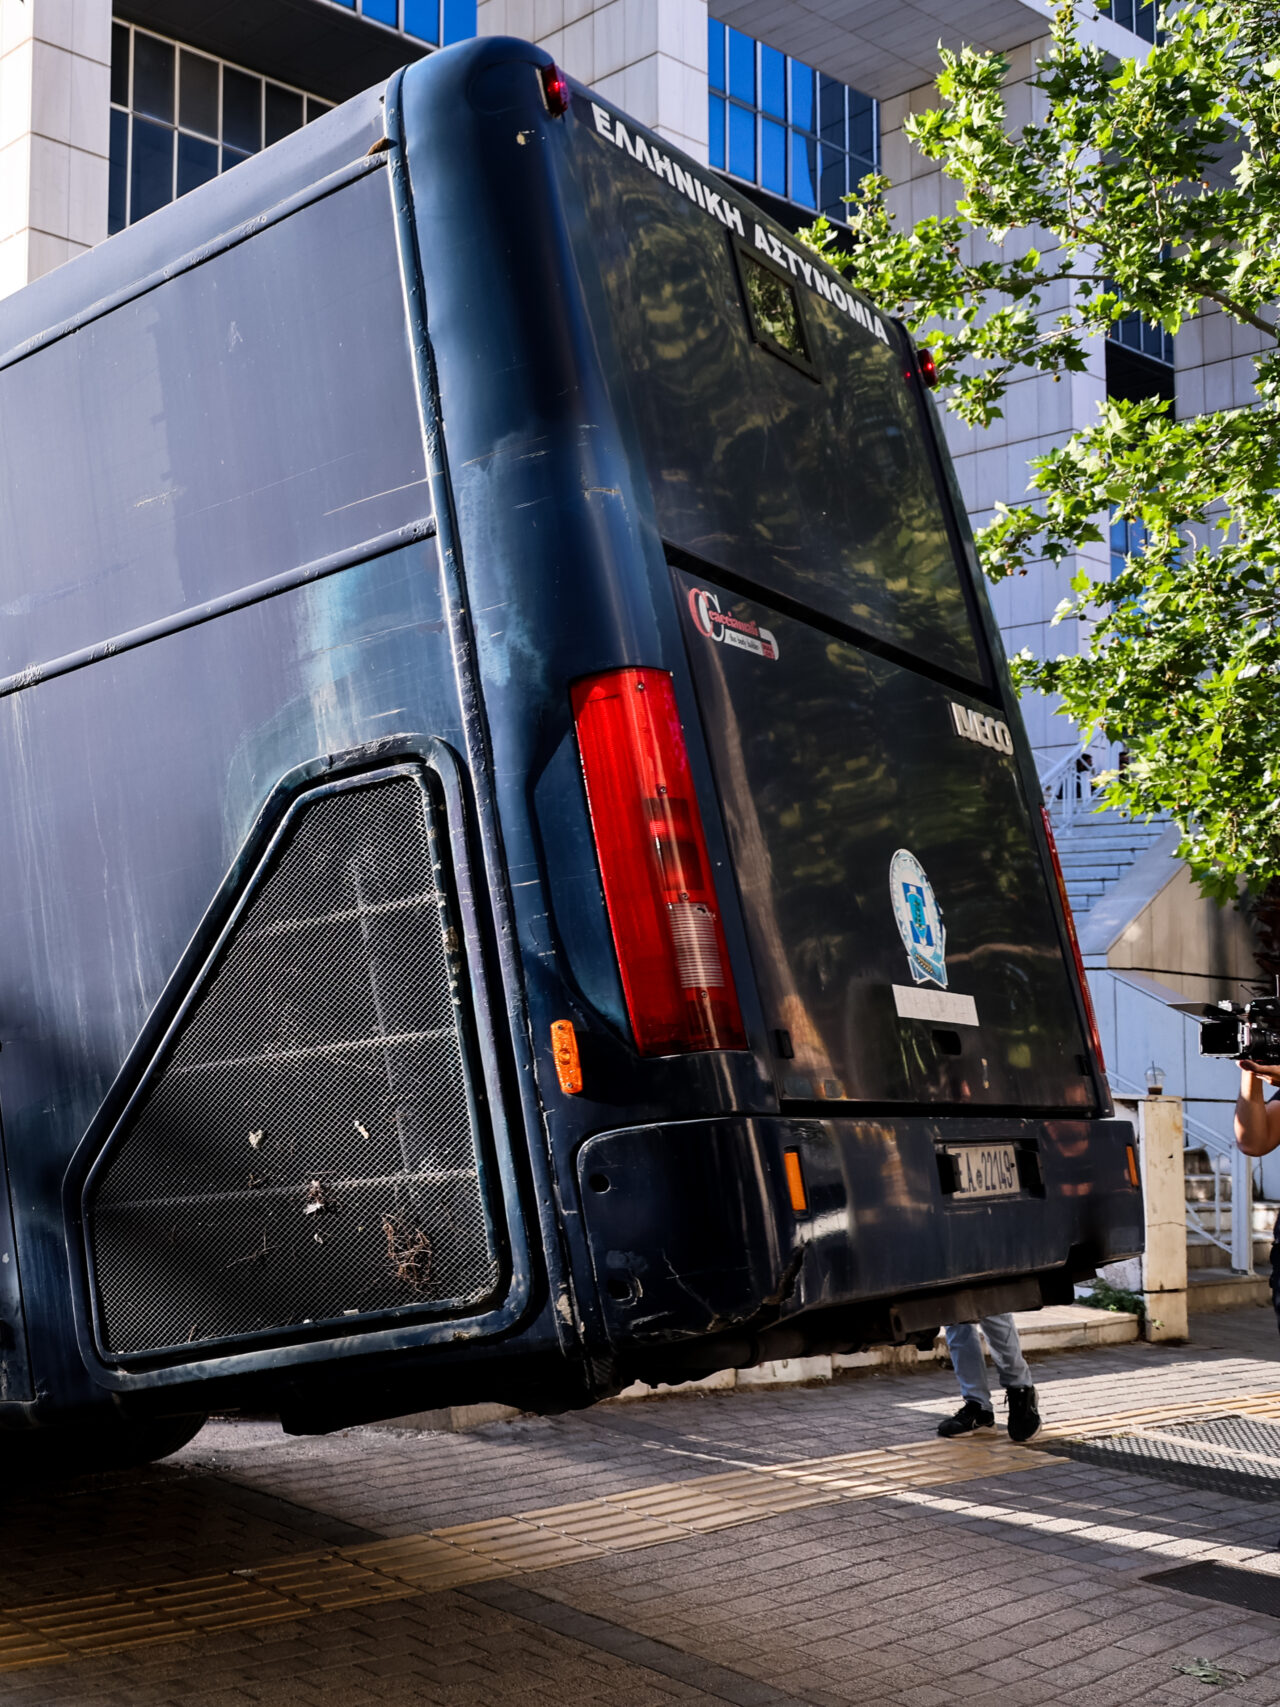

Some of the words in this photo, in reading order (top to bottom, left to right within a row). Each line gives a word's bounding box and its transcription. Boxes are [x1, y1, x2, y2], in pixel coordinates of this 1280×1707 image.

[591, 102, 745, 237] ΕΛΛΗΝΙΚΗ
[754, 224, 890, 346] ΑΣΤΥΝΟΜΙΑ
[951, 702, 1014, 756] IVECO
